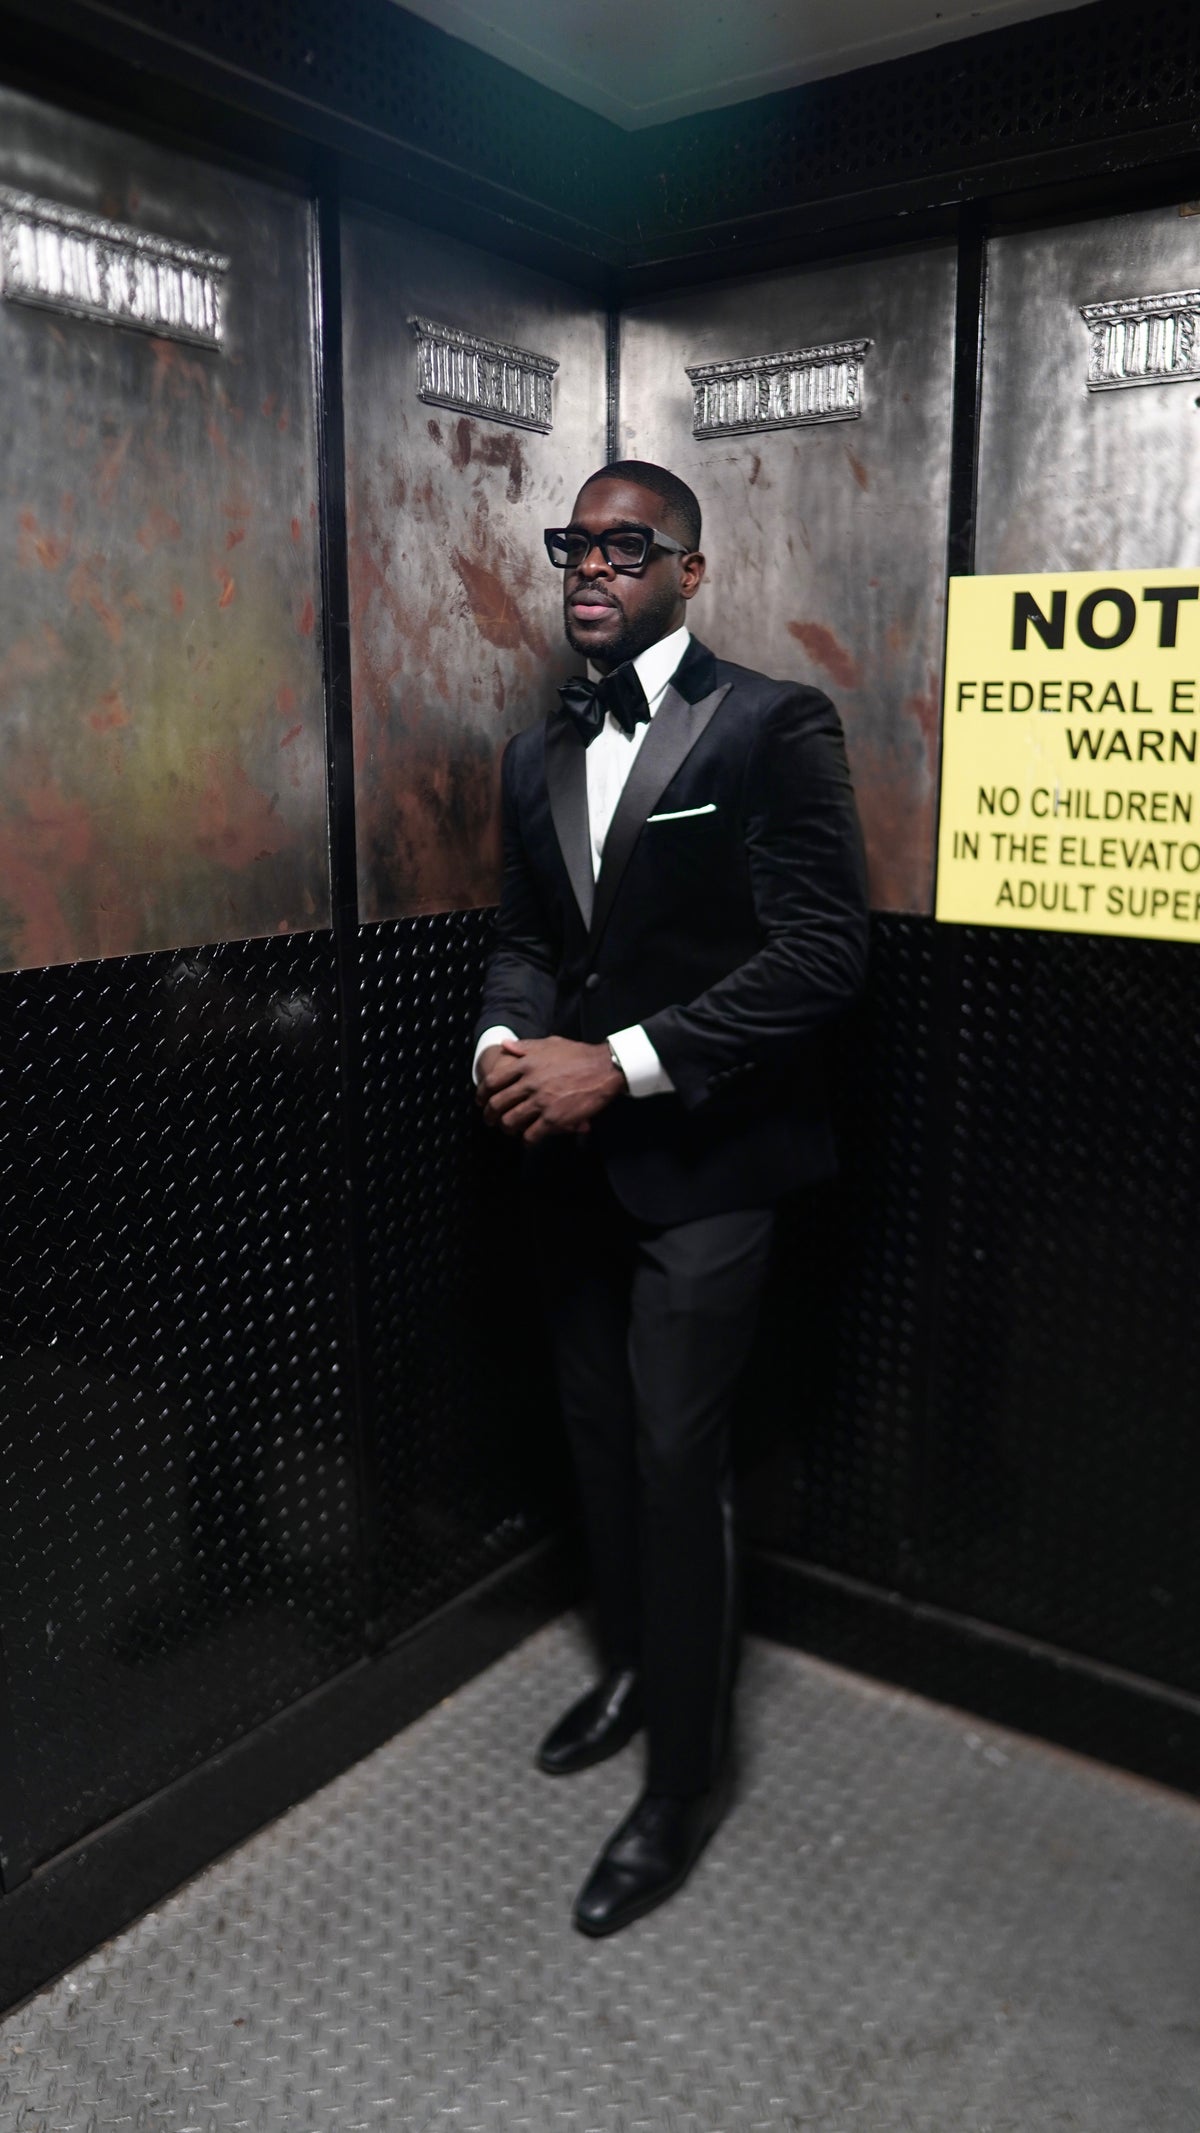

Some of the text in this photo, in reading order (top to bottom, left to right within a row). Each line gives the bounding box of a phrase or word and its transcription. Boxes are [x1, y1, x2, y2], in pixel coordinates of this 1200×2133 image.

[1011, 585, 1200, 651] NOT
[956, 680, 1153, 714] FEDERAL
[1066, 728, 1198, 763] WARN
[977, 786, 1192, 823] NO CHILDREN
[952, 832, 1200, 873] IN THE ELEVATO
[996, 880, 1096, 912] ADULT
